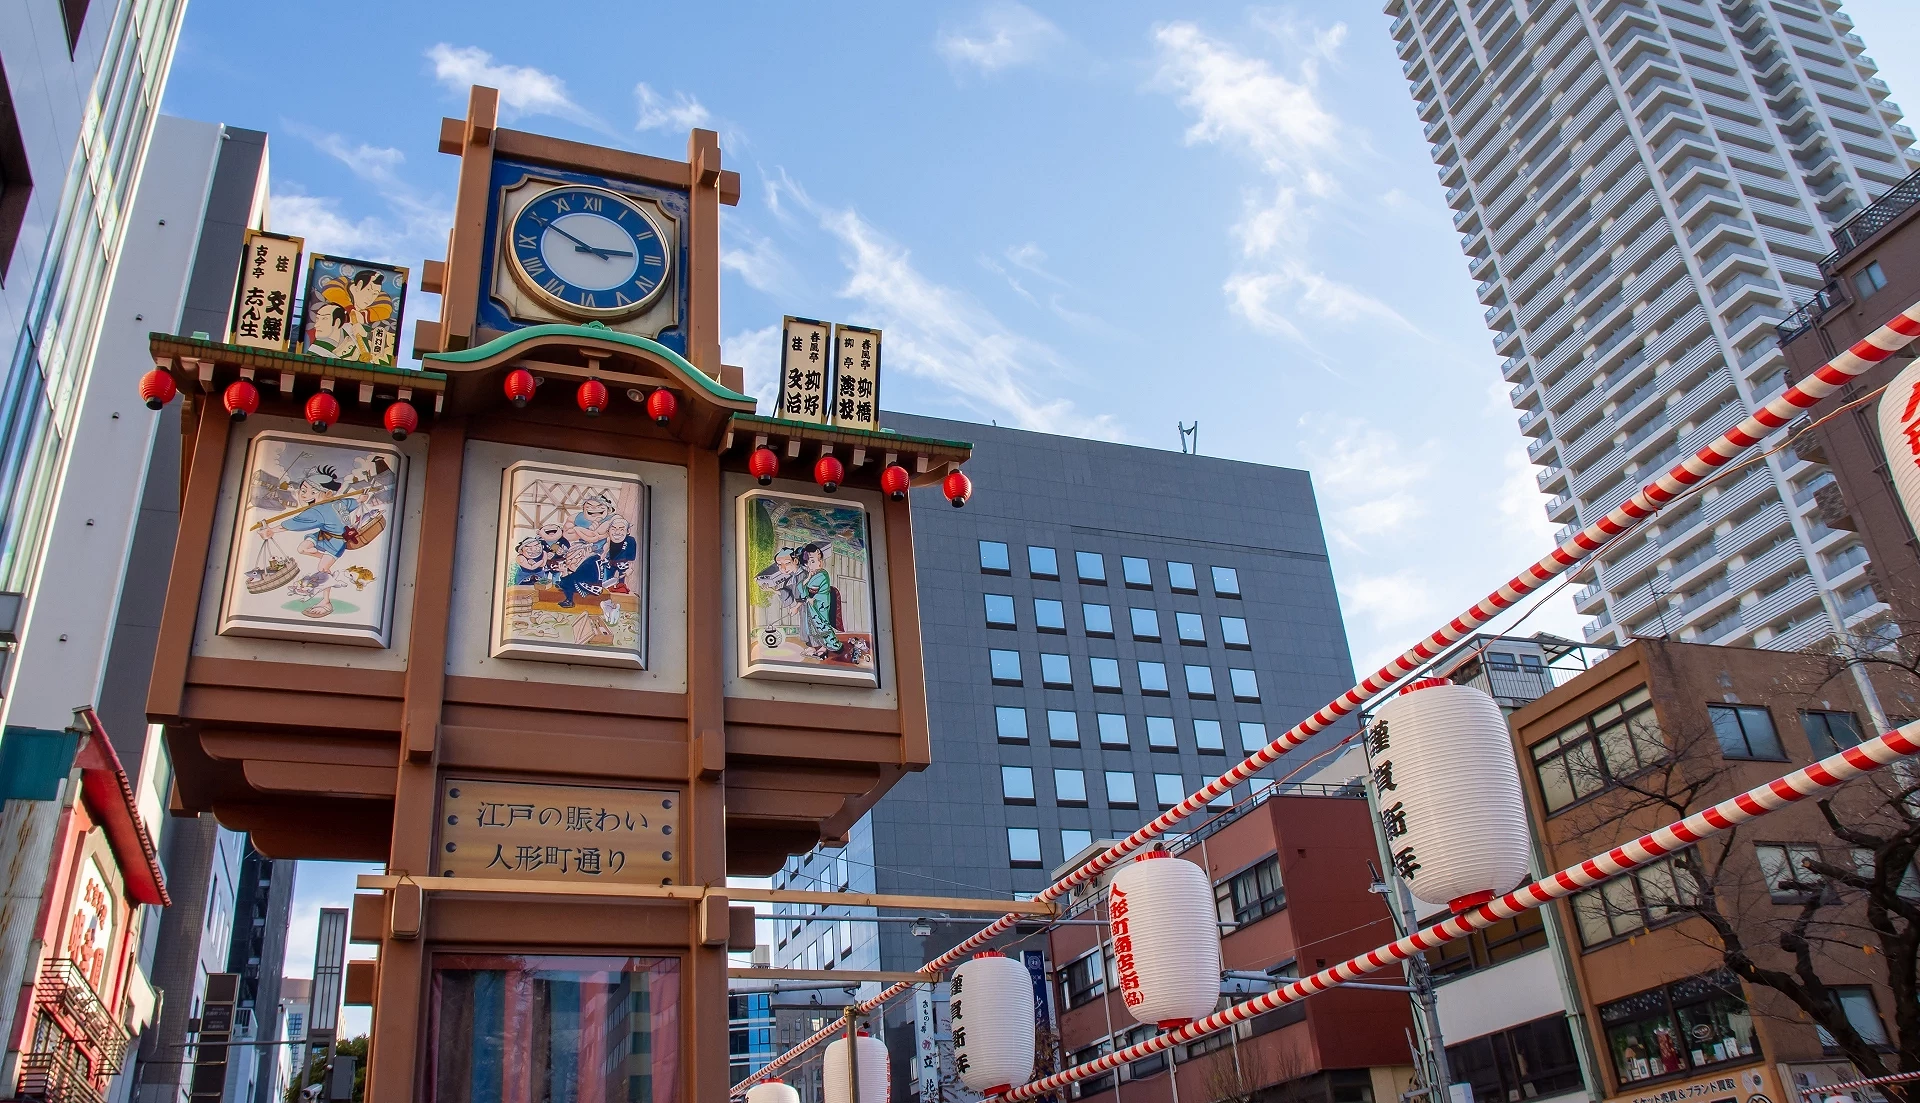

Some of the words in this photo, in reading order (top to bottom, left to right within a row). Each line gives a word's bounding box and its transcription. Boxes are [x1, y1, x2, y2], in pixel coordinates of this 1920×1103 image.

[252, 244, 268, 278] 古今亭
[810, 330, 820, 362] 春風亭
[862, 338, 872, 370] 春風亭
[475, 801, 649, 833] 江戸の賑わい
[485, 843, 627, 875] 人形町通り
